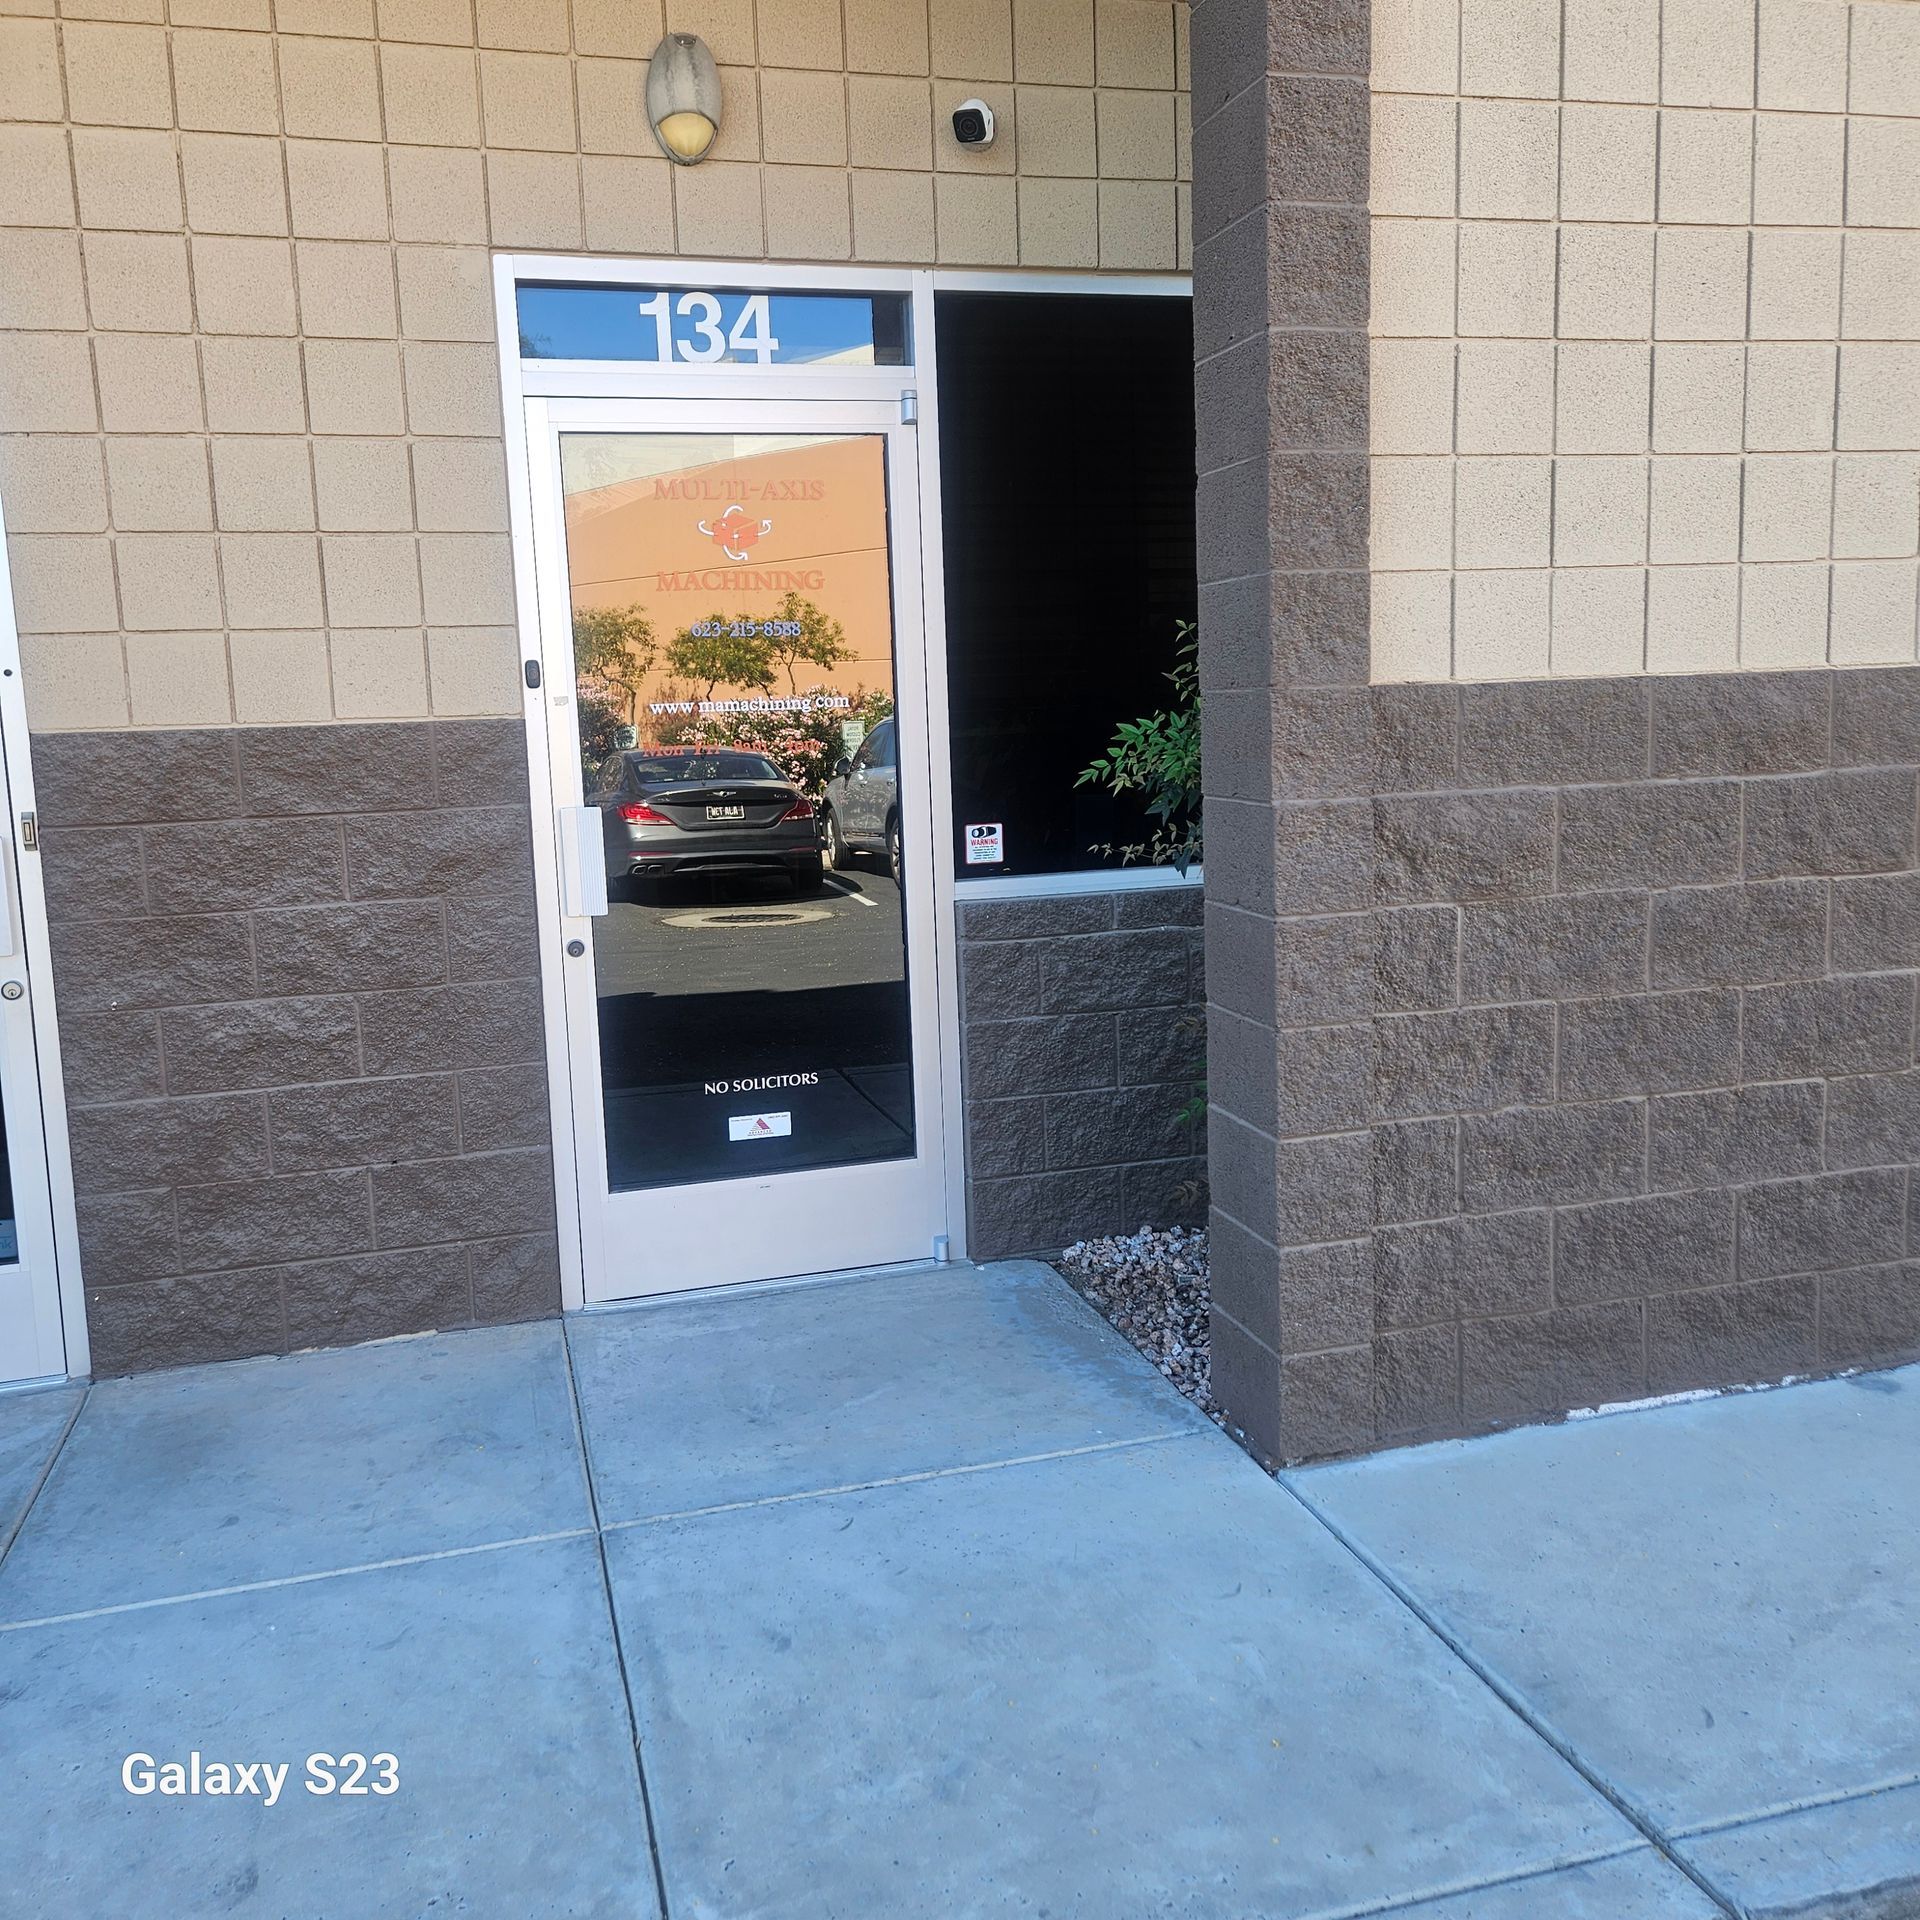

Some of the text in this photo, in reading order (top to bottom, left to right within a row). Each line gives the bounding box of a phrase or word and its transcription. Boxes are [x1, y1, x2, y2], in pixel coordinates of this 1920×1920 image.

[639, 292, 779, 364] 134
[654, 478, 825, 501] MULTI-AXIS
[656, 570, 825, 592] MACHINING
[691, 621, 801, 637] 623-215-8588
[643, 741, 685, 757] Mon
[970, 838, 999, 847] WARNING
[704, 1072, 819, 1095] NO SOLICITORS
